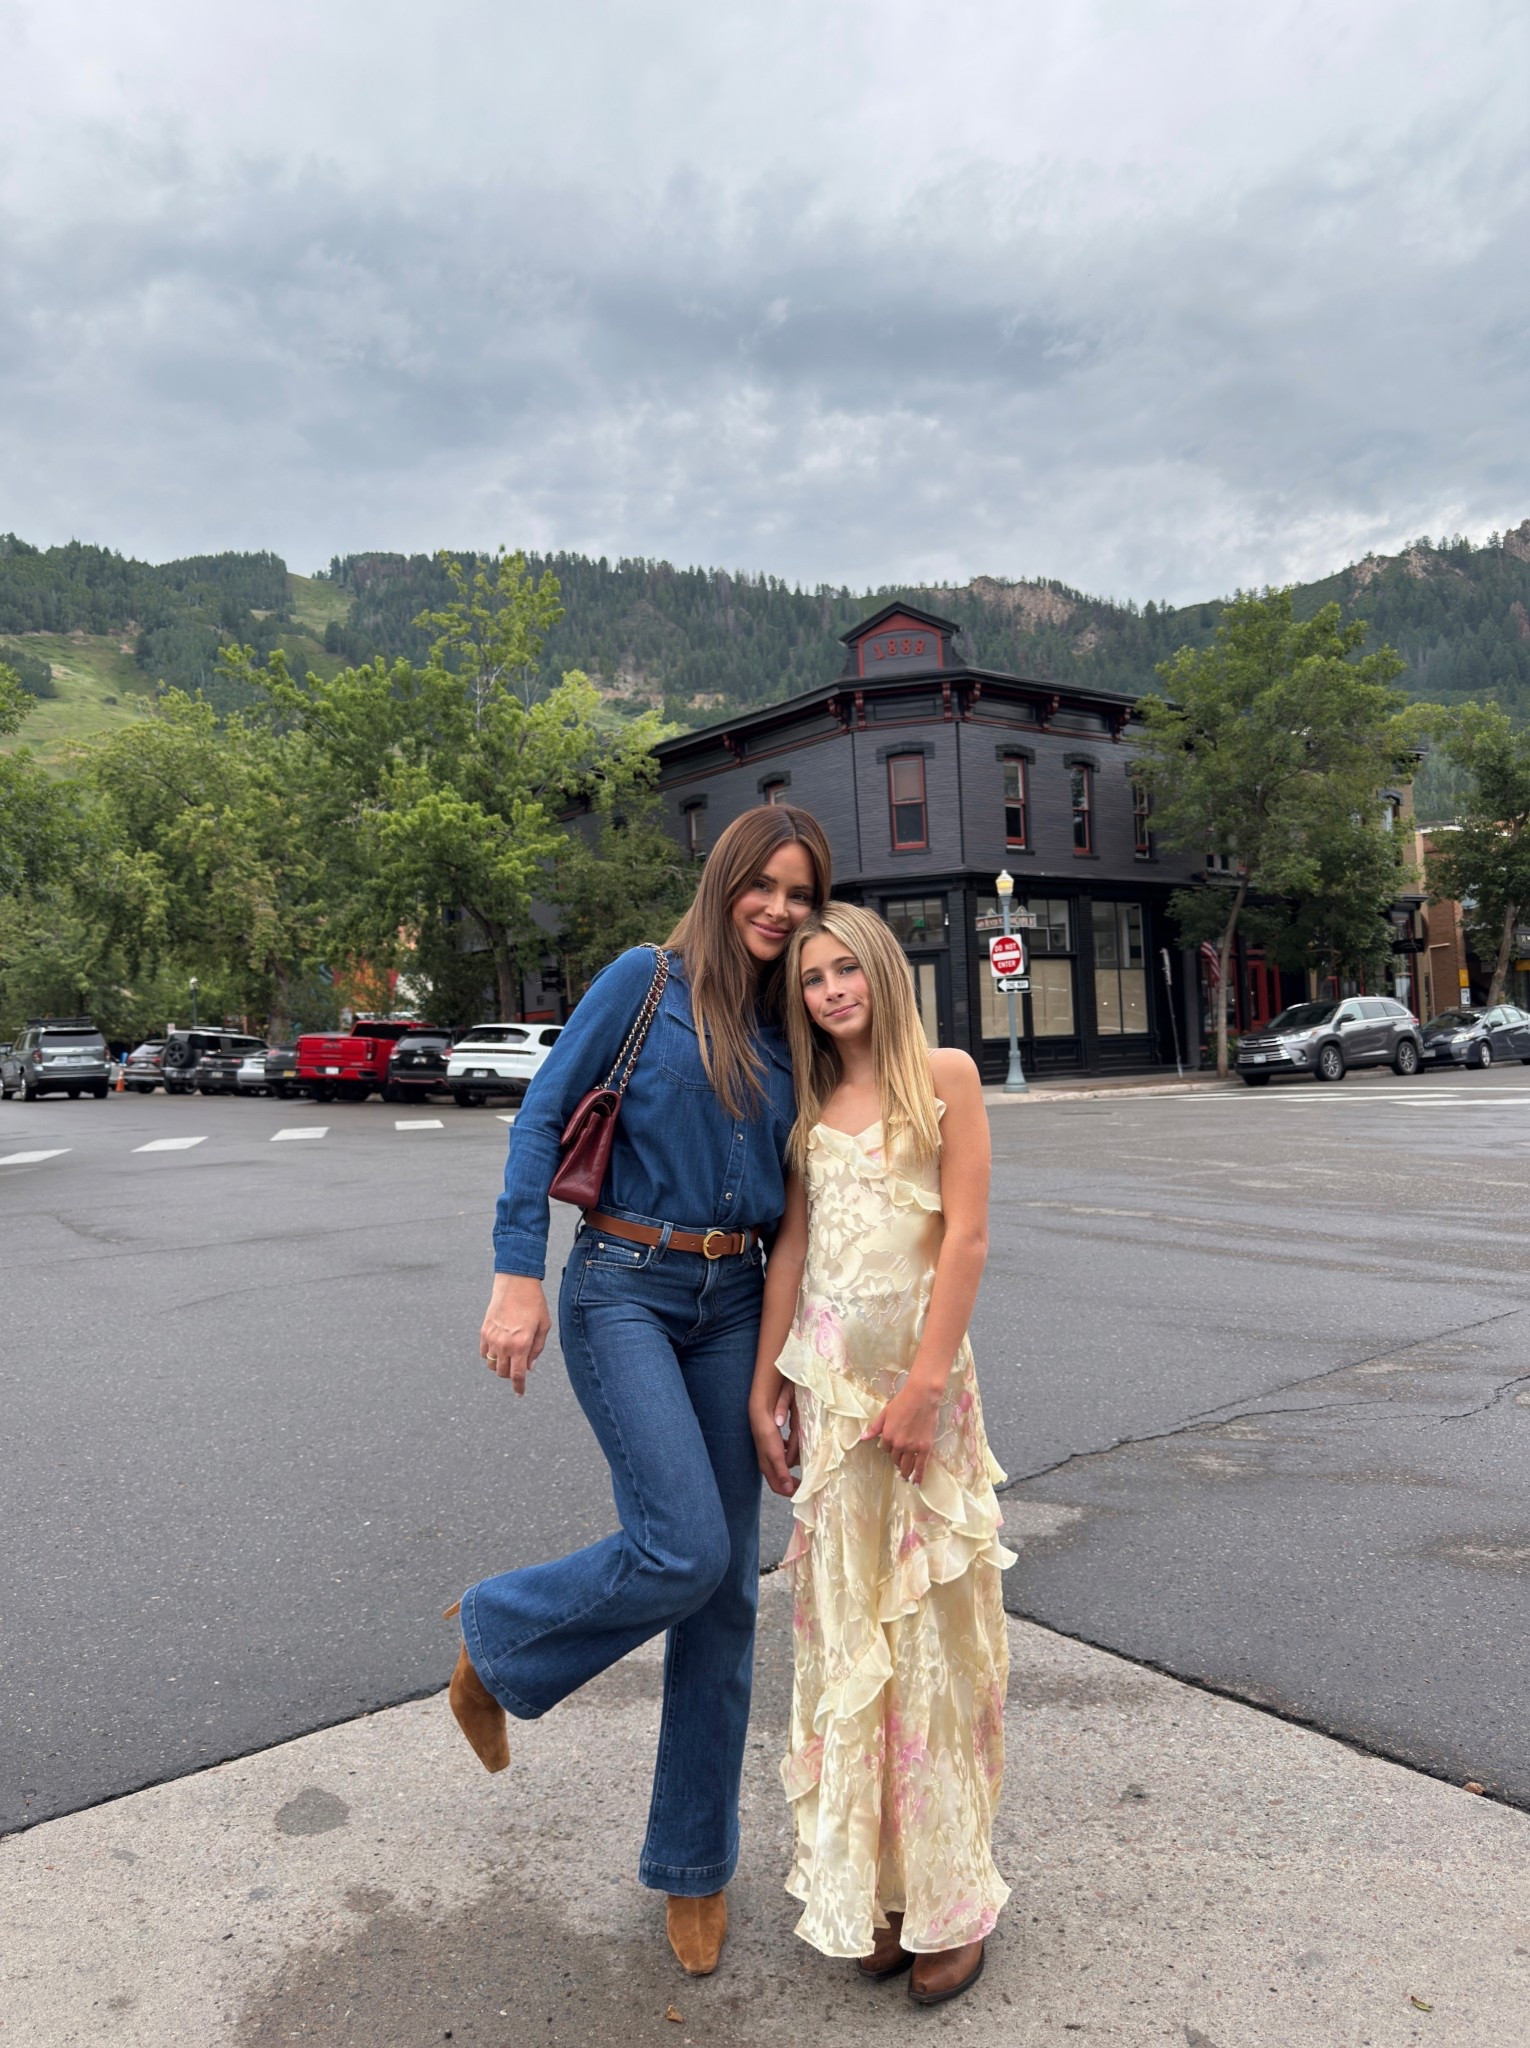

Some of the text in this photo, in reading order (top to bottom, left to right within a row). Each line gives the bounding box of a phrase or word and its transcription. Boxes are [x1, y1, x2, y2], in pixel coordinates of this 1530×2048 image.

[873, 639, 925, 660] 1888
[994, 943, 1017, 952] DO NOT
[997, 960, 1016, 969] ENTER
